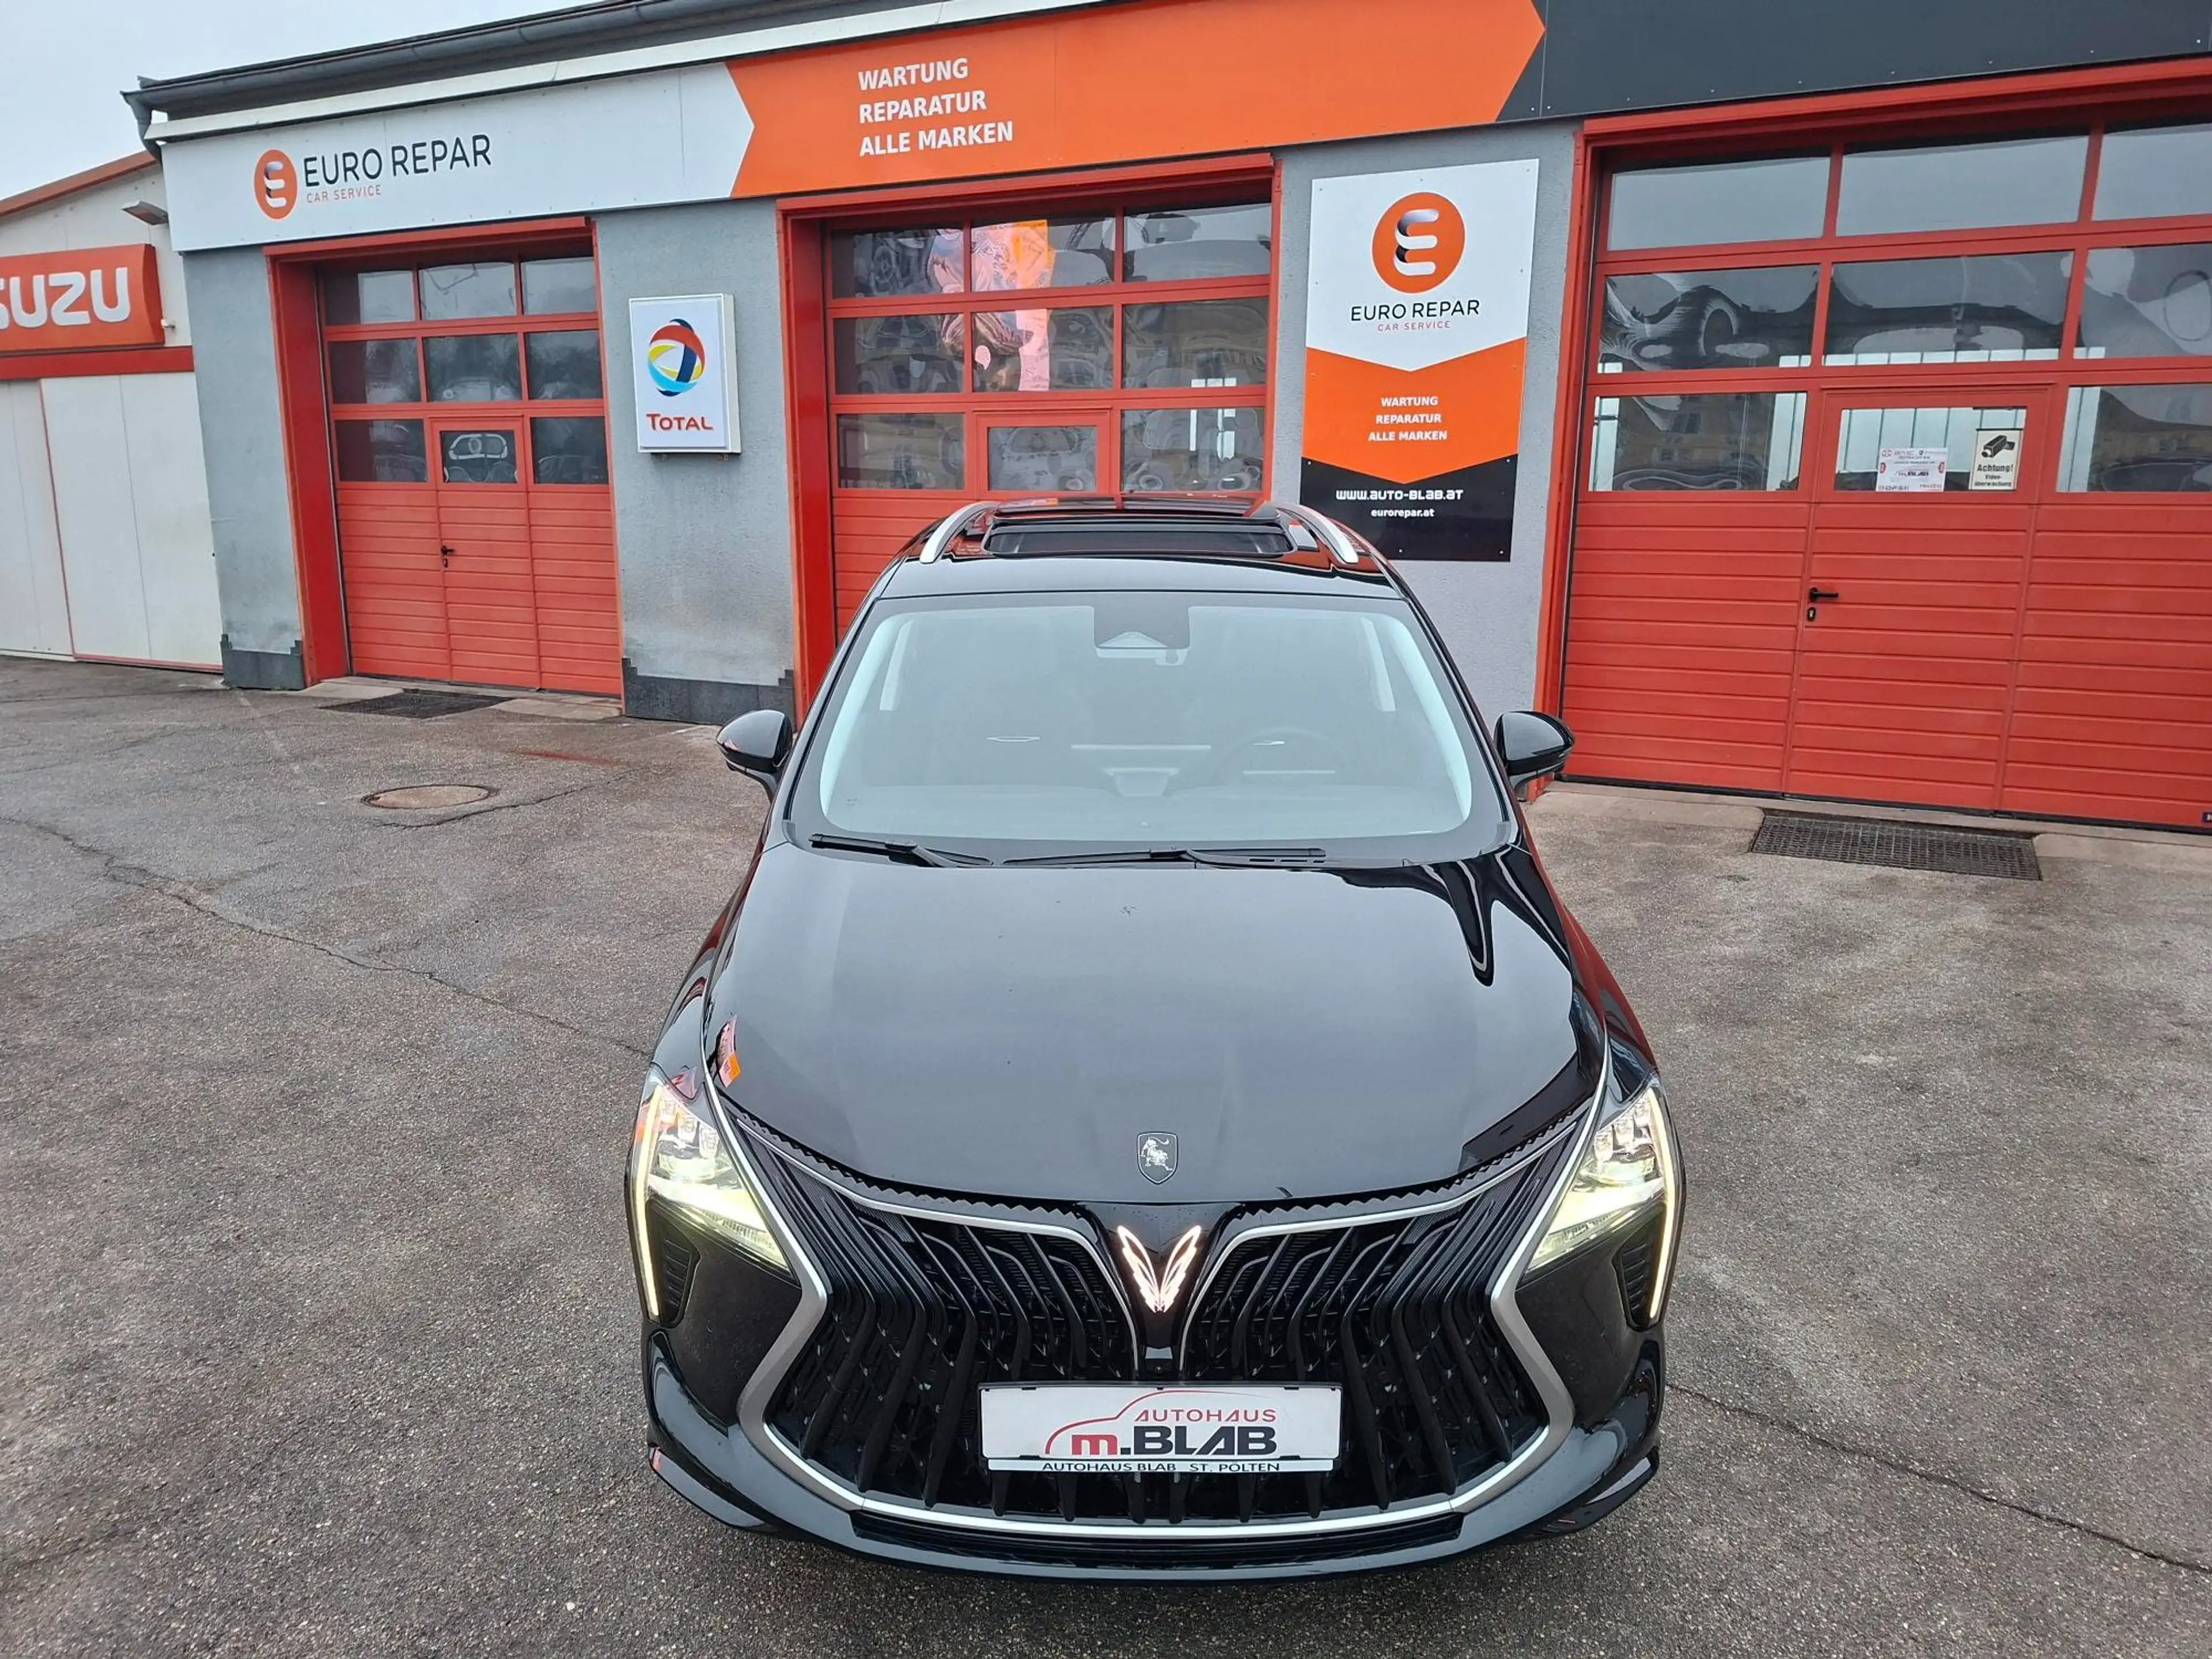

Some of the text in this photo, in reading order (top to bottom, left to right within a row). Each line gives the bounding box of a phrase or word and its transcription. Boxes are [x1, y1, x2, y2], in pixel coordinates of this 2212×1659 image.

[858, 58, 968, 90] WARTUNG
[859, 90, 987, 123] REPARATUR
[859, 121, 1013, 157] ALLE MARKEN
[304, 134, 491, 187] EURO REPAR
[306, 184, 381, 203] CAR SERVICE
[1351, 300, 1479, 321] EURO REPAR
[1378, 321, 1450, 331] CAR SERVICE
[1381, 396, 1438, 407] WARTUNG
[646, 414, 714, 430] TOTAL
[1376, 414, 1442, 424] REPARATUR
[1368, 430, 1447, 441] ALLE MARKEN
[1977, 464, 2013, 472] Achtung!
[1371, 509, 1434, 518] eurorepar.at
[1134, 1409, 1277, 1422] AUTOHAUS
[1190, 1463, 1212, 1472] ST.
[1219, 1461, 1280, 1472] PÖLTEN
